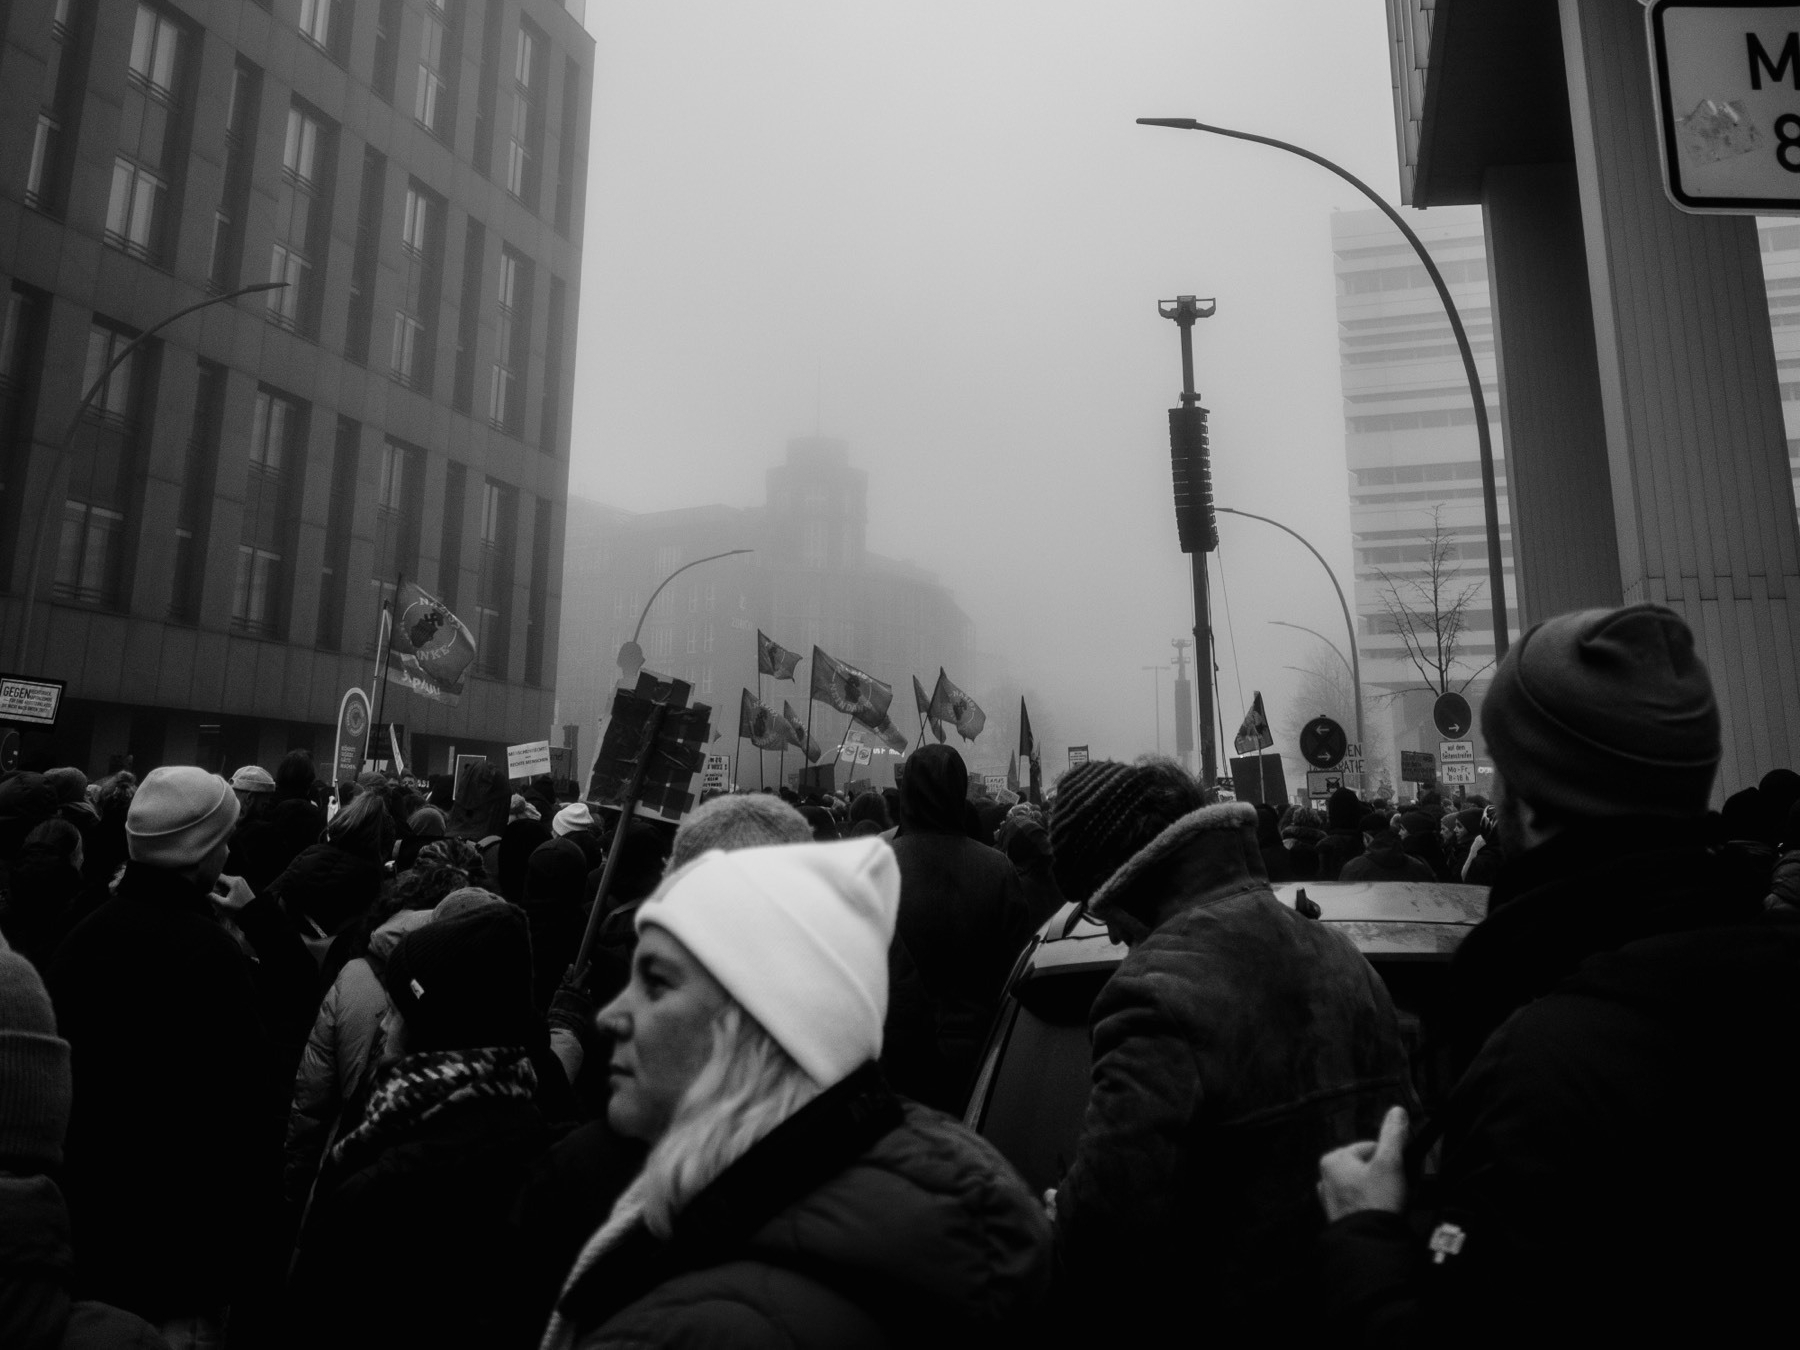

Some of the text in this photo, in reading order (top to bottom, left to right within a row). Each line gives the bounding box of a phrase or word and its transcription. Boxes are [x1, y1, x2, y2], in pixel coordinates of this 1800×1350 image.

[3, 686, 30, 699] GEGEN
[1442, 752, 1472, 760] Seitenstreifen
[510, 760, 525, 768] RECHTE
[525, 757, 548, 765] MENSCHEN
